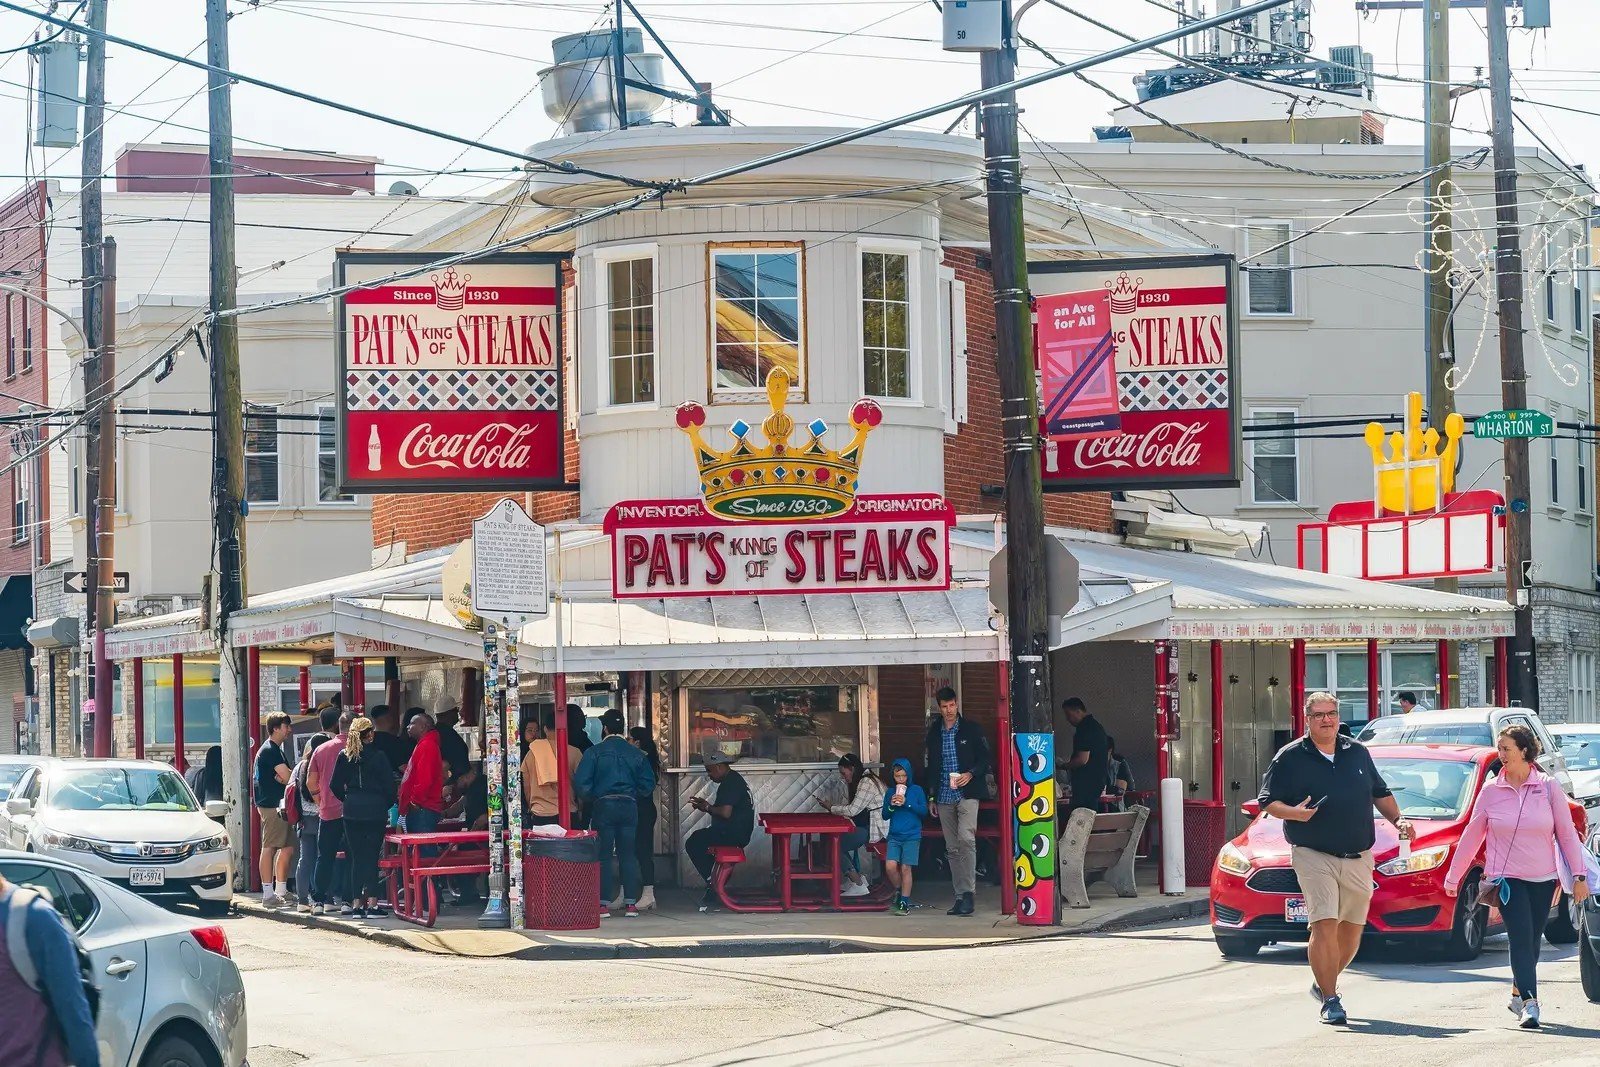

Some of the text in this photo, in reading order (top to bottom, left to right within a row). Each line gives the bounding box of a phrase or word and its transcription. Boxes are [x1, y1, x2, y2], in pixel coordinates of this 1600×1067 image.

[957, 31, 966, 40] 50
[393, 291, 499, 301] Since 1930
[1140, 293, 1170, 304] 1930
[1053, 303, 1095, 317] an Ave
[1054, 315, 1096, 330] for All
[352, 314, 553, 366] PAT'S KING STEAKS
[1129, 314, 1223, 368] STEAKS
[429, 342, 446, 355] OF
[1477, 420, 1550, 436] WHARTON ST
[398, 422, 539, 469] Coca-Cola
[617, 503, 702, 520] INVENTOR
[730, 498, 830, 514] Since 1930
[856, 497, 945, 514] ORIGINATOR
[624, 527, 939, 588] PAT'S KING STEAKS
[745, 560, 768, 579] OF
